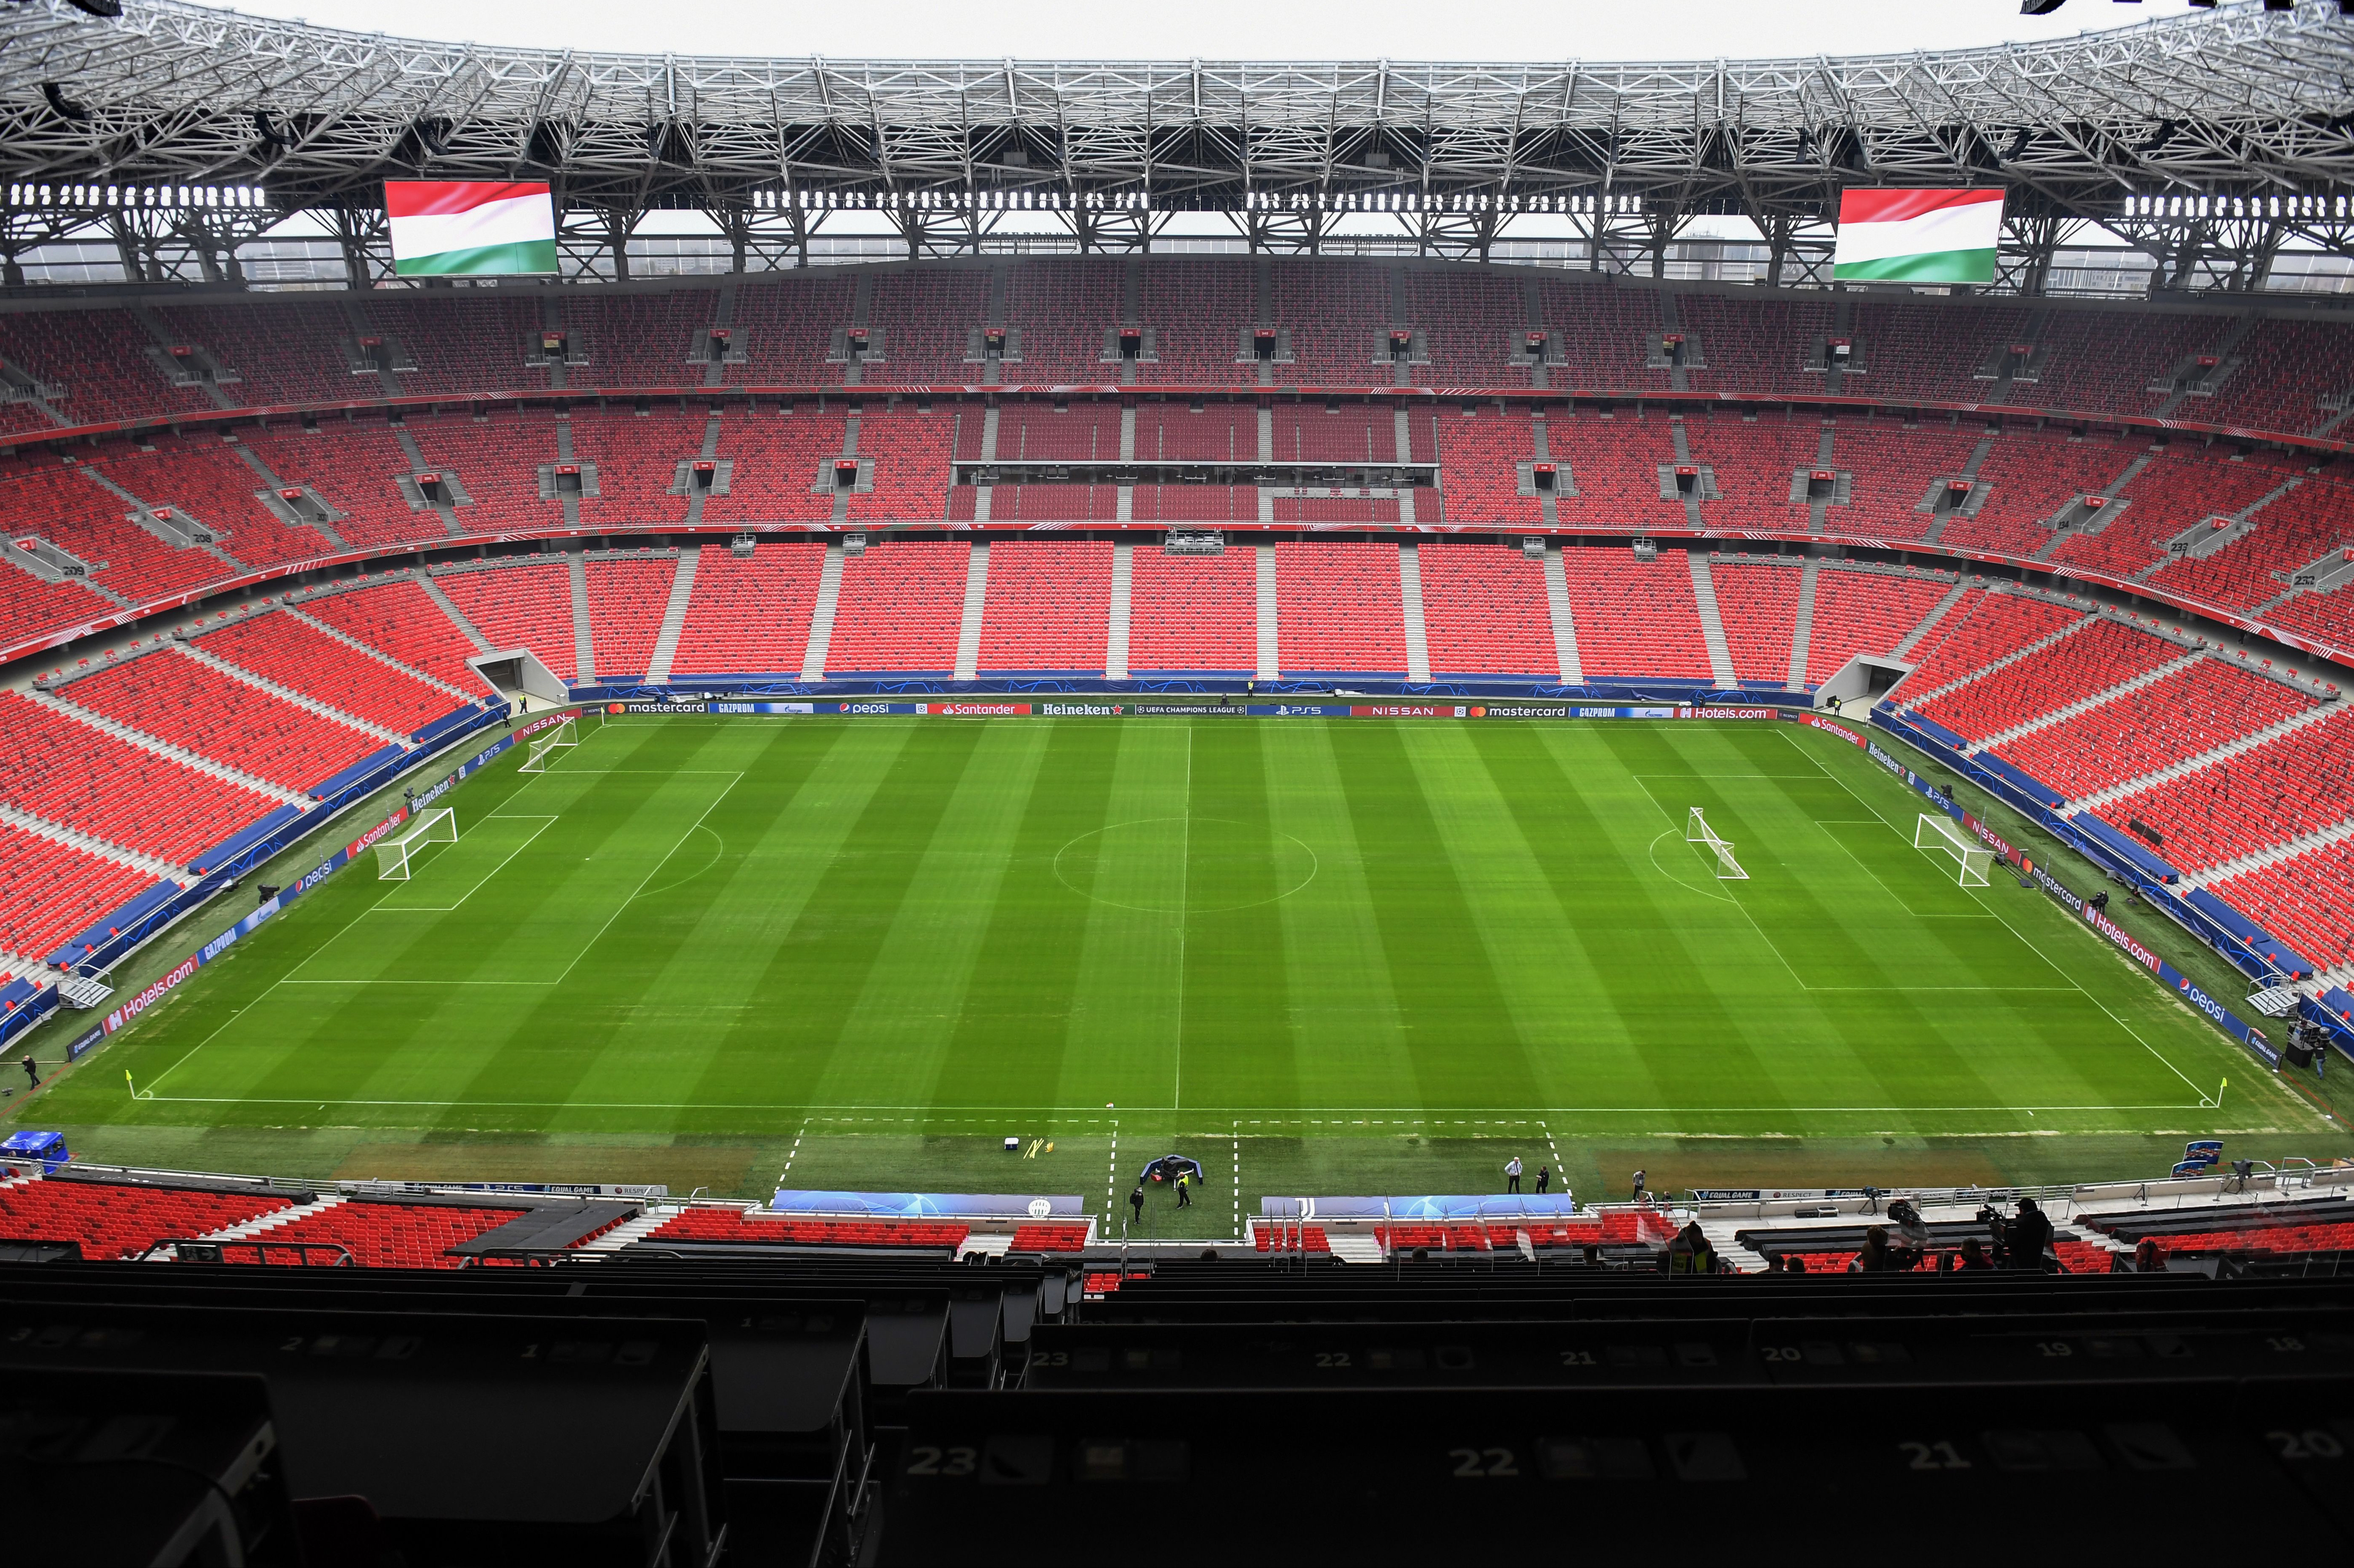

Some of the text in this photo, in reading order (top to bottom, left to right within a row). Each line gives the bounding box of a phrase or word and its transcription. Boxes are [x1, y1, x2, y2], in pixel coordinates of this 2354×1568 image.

[629, 703, 705, 712] mastercard
[719, 703, 755, 713] GAZPROM
[853, 704, 889, 714] pepsi
[955, 704, 1015, 714] Santander
[1043, 704, 1110, 715] Heineken
[1489, 707, 1565, 717] mastercard
[1579, 708, 1615, 717] GAZPROM
[1695, 708, 1766, 718] Hotels.com
[523, 713, 565, 737] NISSAN
[1821, 718, 1859, 745] Santander
[485, 744, 500, 758] PS5
[1868, 742, 1899, 774] Heineken
[412, 779, 449, 813] Heineken
[1933, 792, 1950, 810] PS5
[204, 927, 237, 960] GAZPROM
[2097, 914, 2154, 969] Hotels.com
[123, 961, 193, 1020] Hotels.com
[2189, 988, 2225, 1022] pepsi
[741, 1318, 752, 1327] 1
[280, 1337, 304, 1351] 2
[521, 1344, 538, 1358] 1
[2036, 1342, 2073, 1356] 19
[2266, 1337, 2305, 1351] 18
[1032, 1352, 1069, 1366] 23
[1315, 1353, 1351, 1367] 22
[1560, 1351, 1597, 1365] 21
[1761, 1347, 1802, 1361] 20
[2266, 1430, 2344, 1458] 20
[907, 1447, 977, 1475] 23
[1448, 1447, 1519, 1477] 22
[1898, 1441, 1972, 1469] 21
